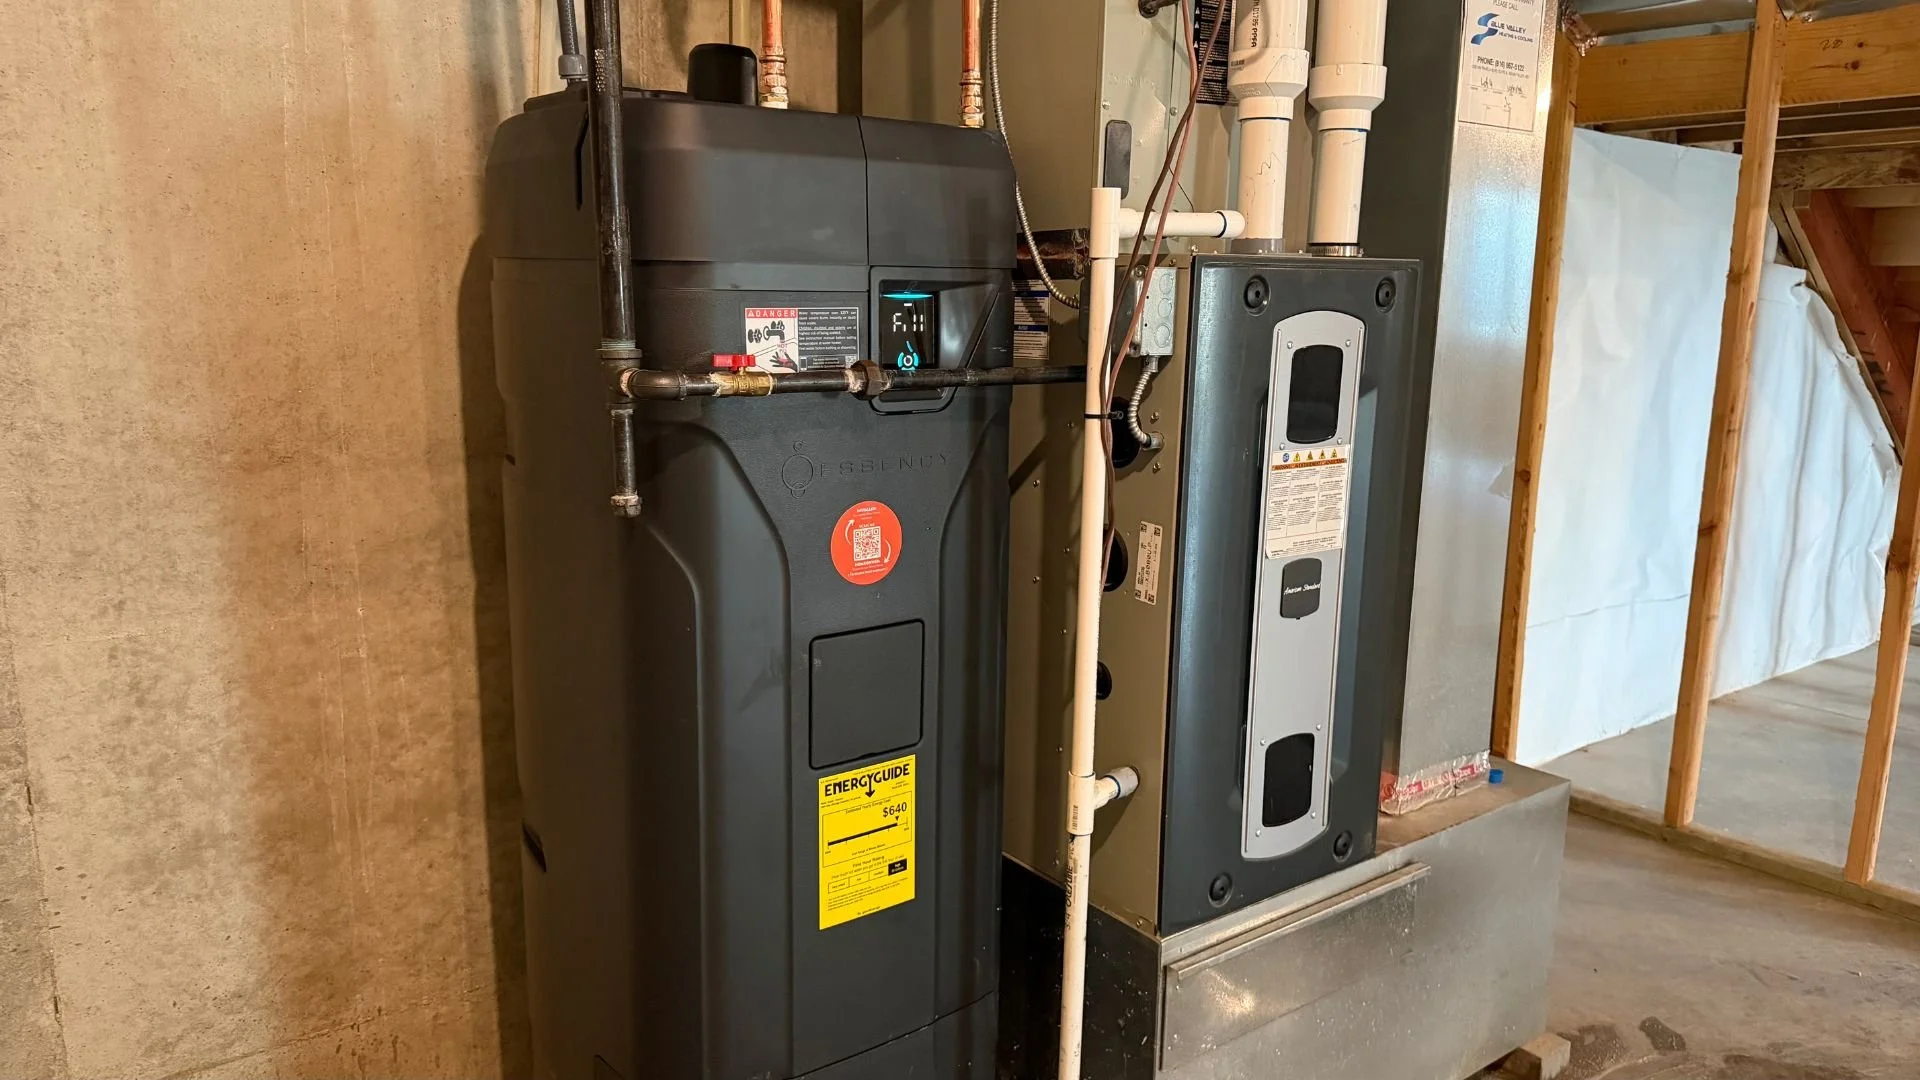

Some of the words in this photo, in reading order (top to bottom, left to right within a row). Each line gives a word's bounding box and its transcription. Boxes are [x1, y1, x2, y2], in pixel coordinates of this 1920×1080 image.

[1491, 21, 1505, 29] BLUE
[1506, 24, 1526, 34] VALLEY
[1477, 56, 1494, 66] PHONE:
[755, 310, 796, 318] DANGER
[820, 455, 947, 477] ESSENCY
[825, 764, 910, 797] ENERGYGUIDE
[882, 801, 908, 818] $640
